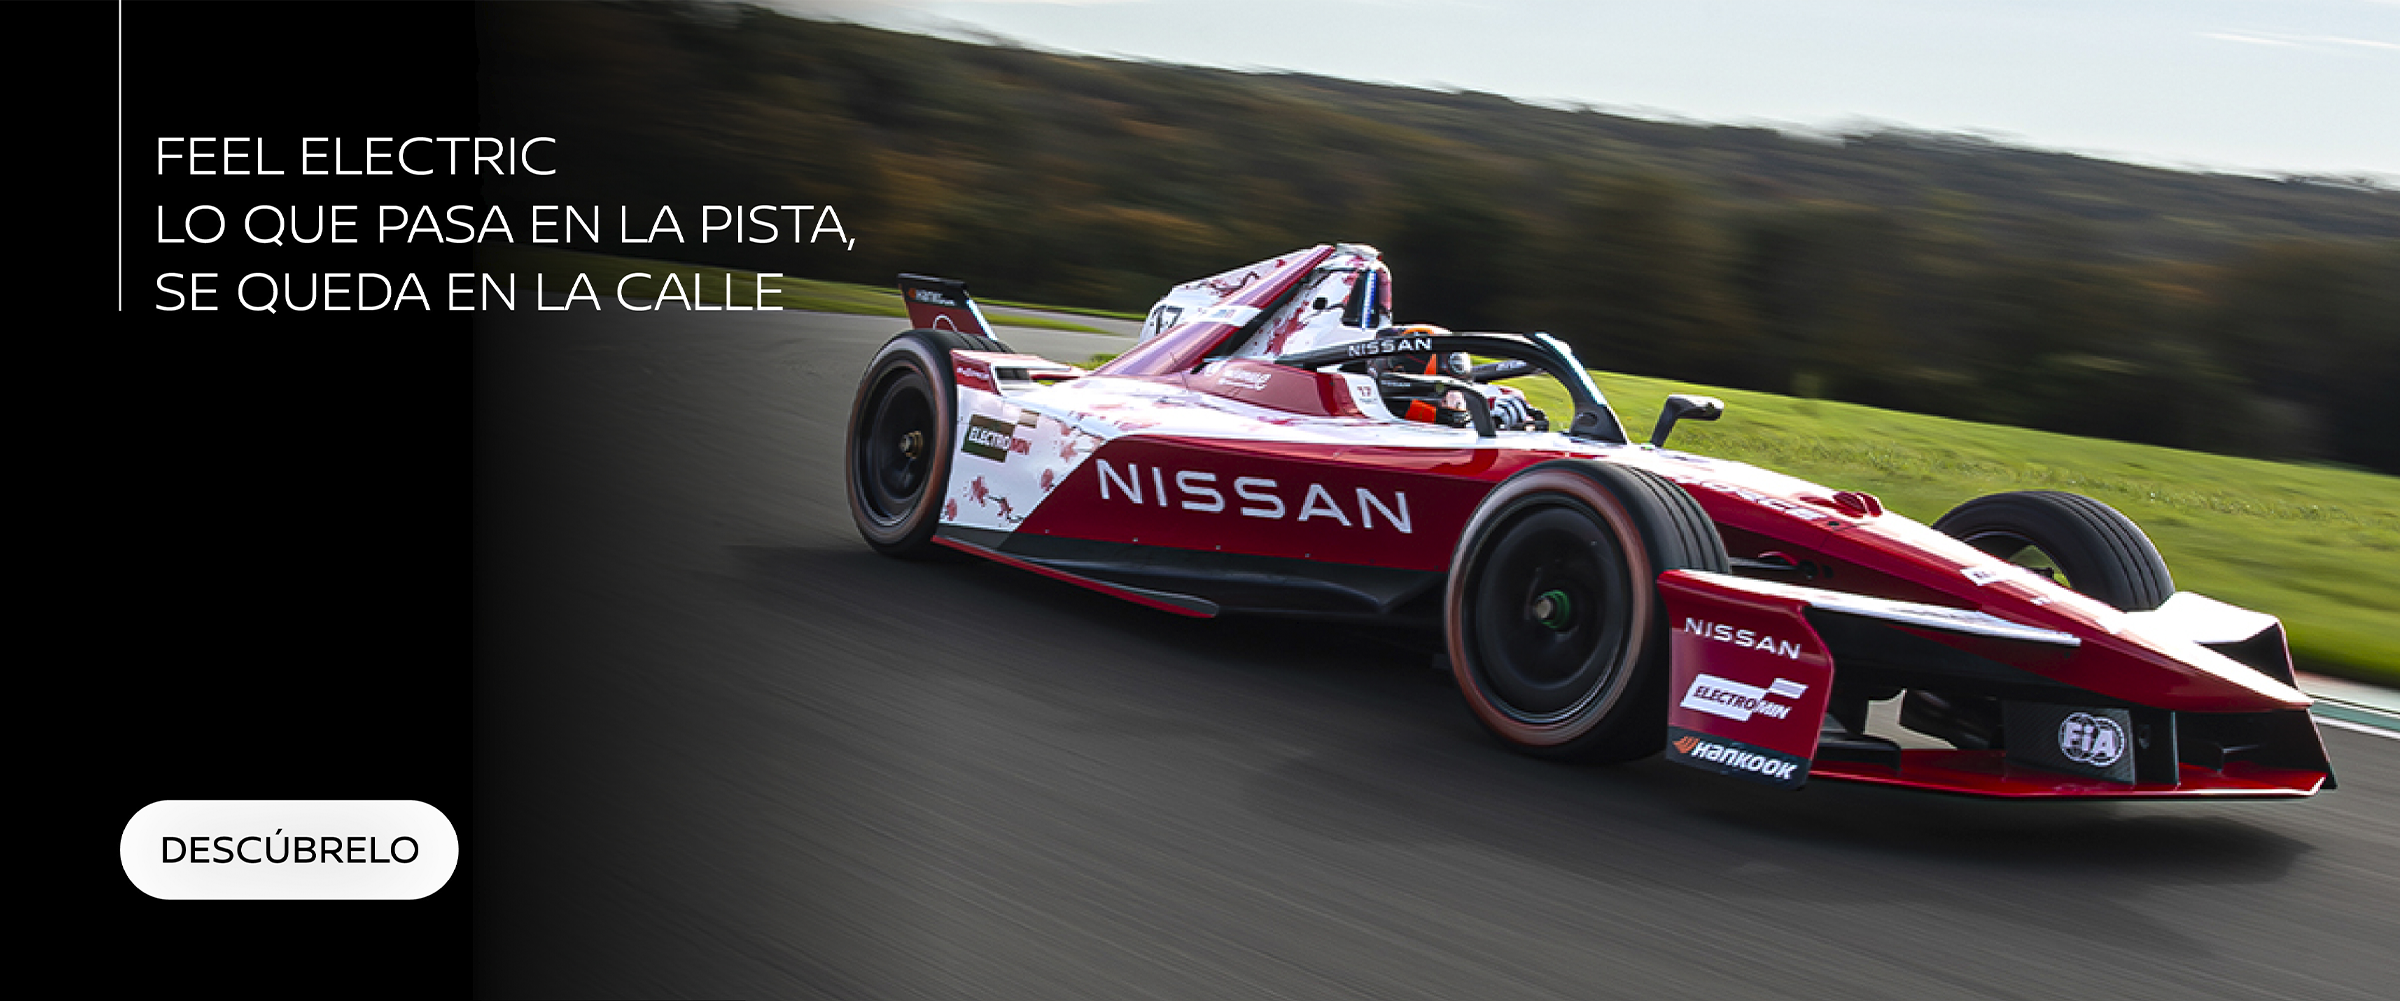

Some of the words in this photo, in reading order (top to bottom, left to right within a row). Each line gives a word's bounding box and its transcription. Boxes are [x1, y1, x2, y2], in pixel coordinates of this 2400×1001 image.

[1348, 337, 1432, 358] NISSAN
[1095, 458, 1413, 535] NISSAN
[1684, 616, 1801, 660] NISSAN
[1692, 685, 1793, 719] ELECTROMIN
